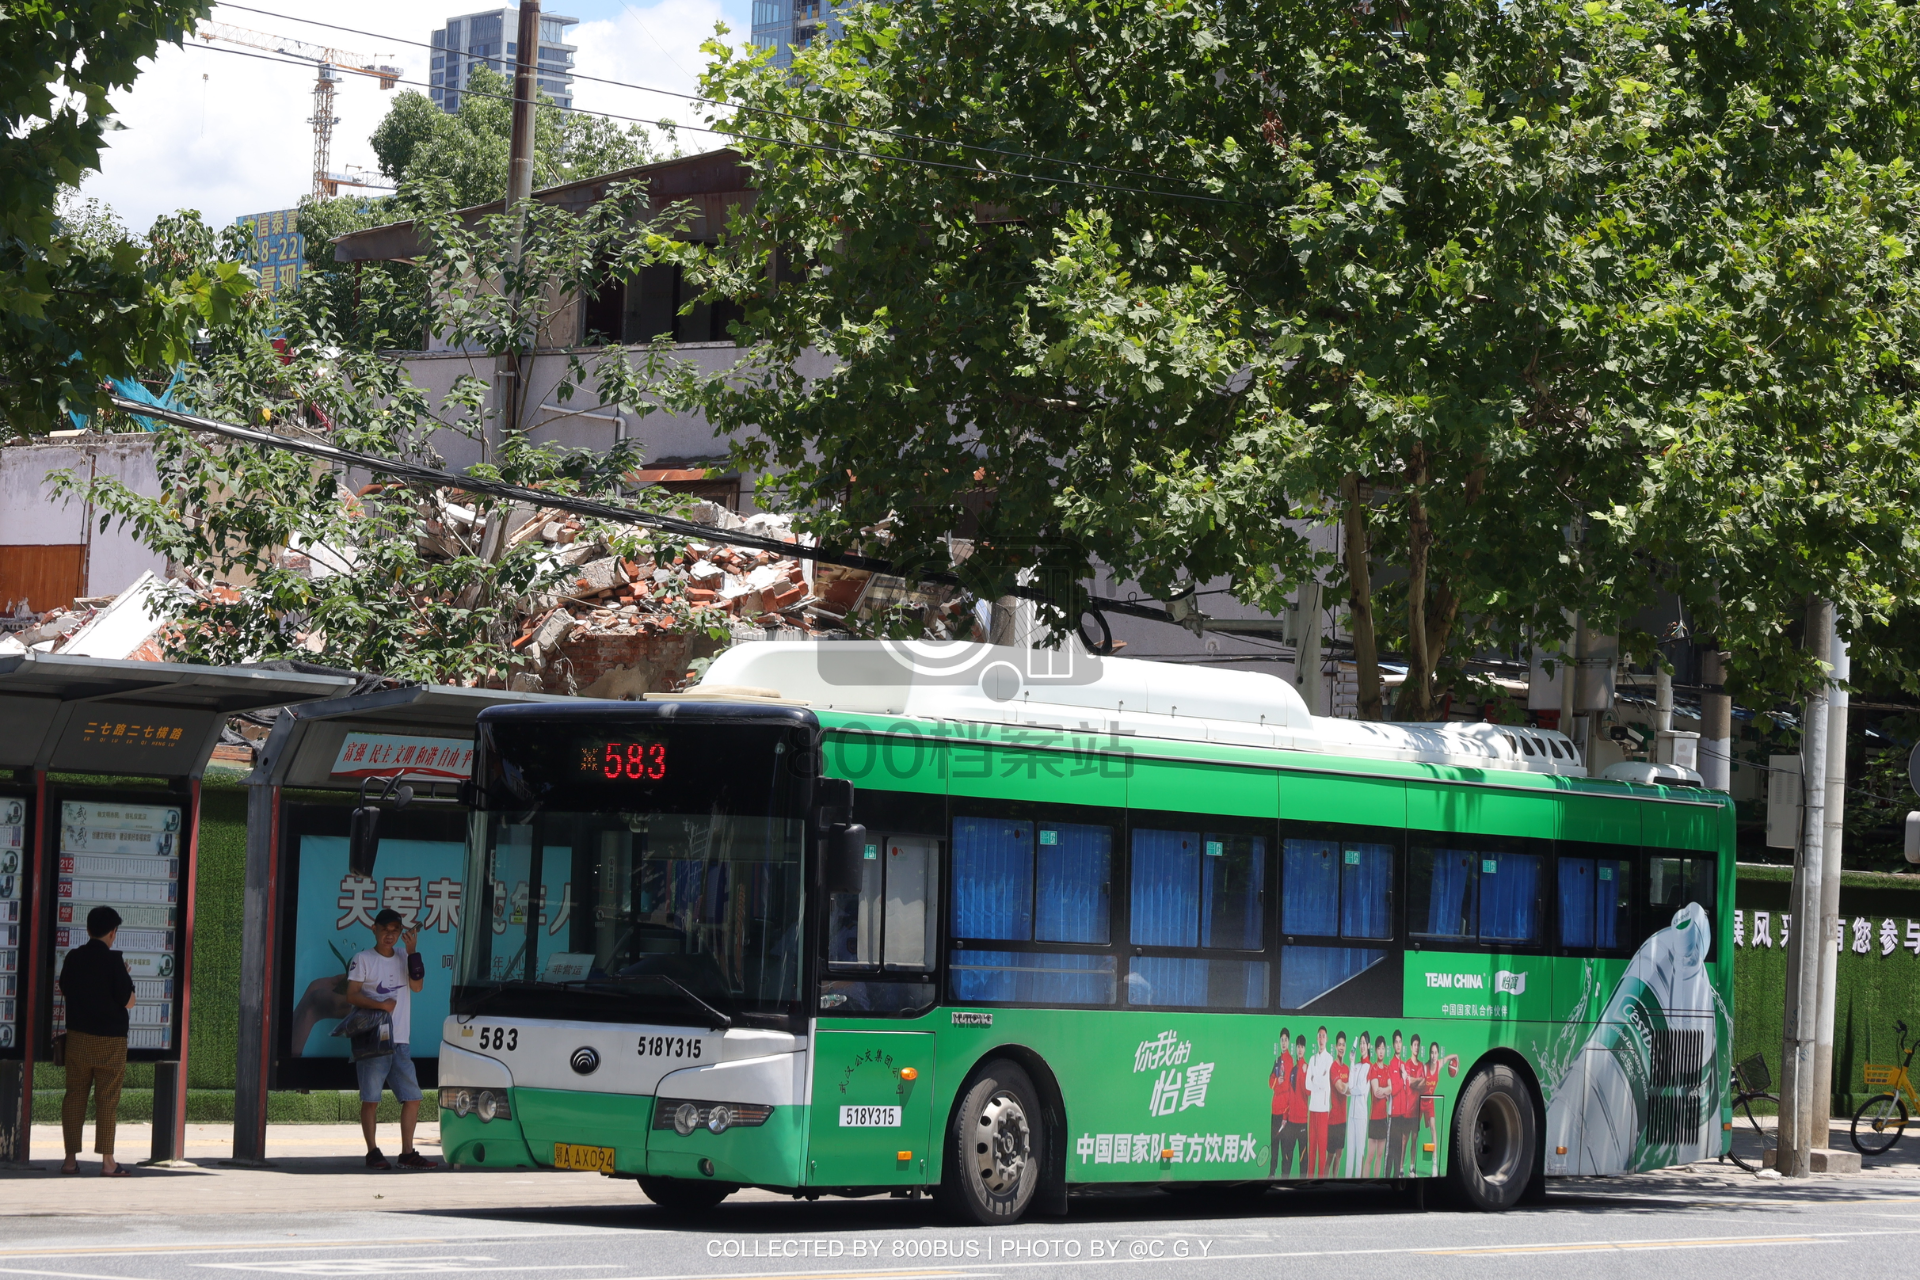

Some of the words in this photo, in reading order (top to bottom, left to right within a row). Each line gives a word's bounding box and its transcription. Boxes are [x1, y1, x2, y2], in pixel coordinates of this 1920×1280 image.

[84, 722, 183, 740] 二七路二七横路
[342, 741, 368, 762] 富强
[368, 743, 393, 764] 民主
[390, 744, 417, 765] 文明
[414, 745, 439, 766] 和谐
[437, 746, 460, 768] 自由
[604, 743, 666, 779] 583
[60, 859, 74, 868] 212
[58, 883, 72, 893] 375
[552, 964, 584, 976] 非营运
[1425, 972, 1452, 988] TEAM
[1454, 973, 1483, 989] CHINA
[1441, 1003, 1508, 1017] 中国国家队合作伙伴
[479, 1027, 518, 1051] 583
[637, 1036, 702, 1059] 518Y315
[1133, 1029, 1192, 1073] 你我的
[846, 1107, 895, 1125] 518Y315
[1076, 1132, 1257, 1164] 中国国家队官方饮用水
